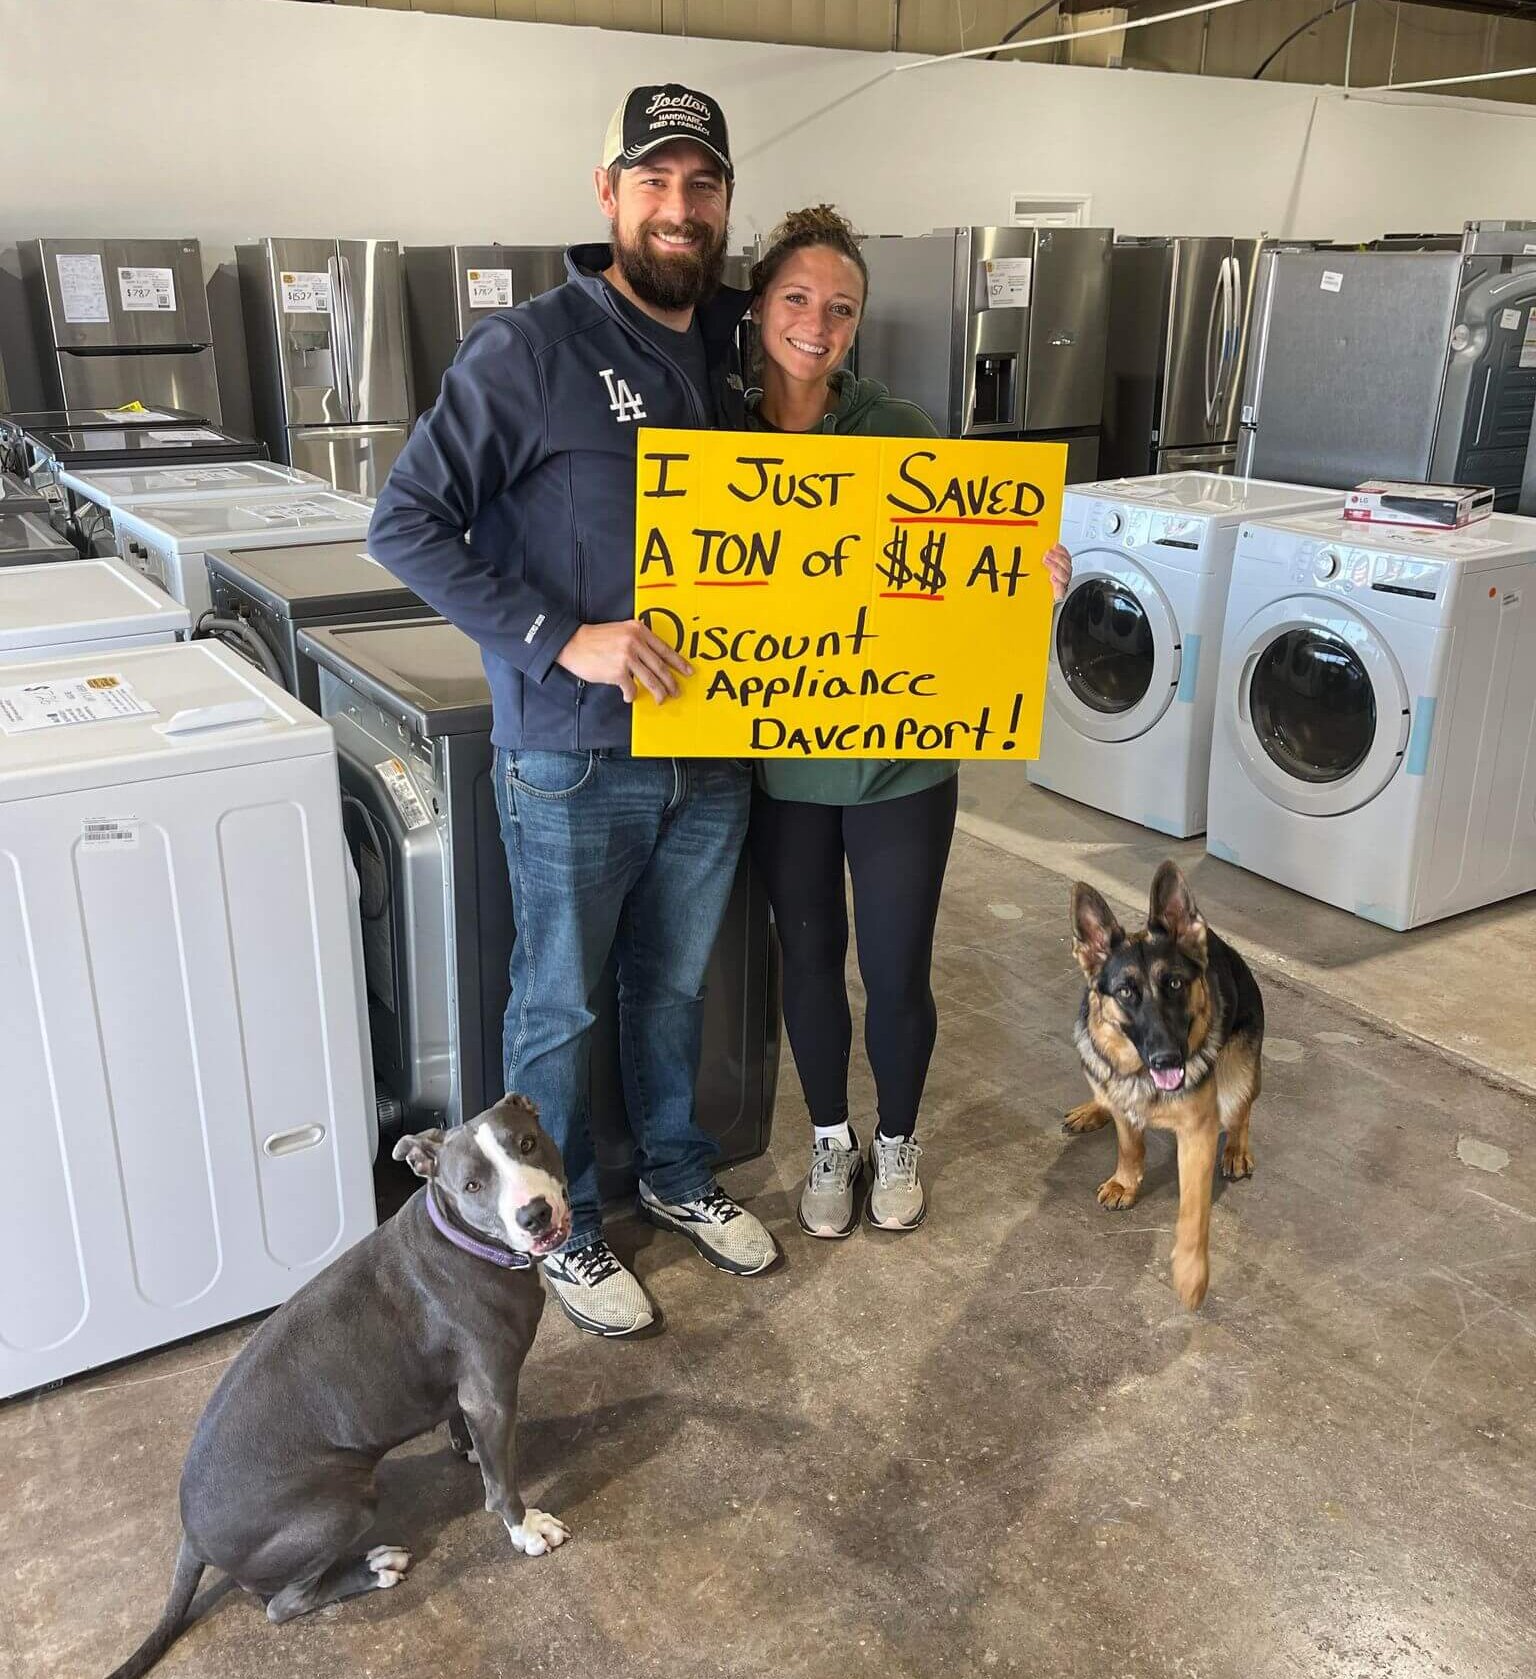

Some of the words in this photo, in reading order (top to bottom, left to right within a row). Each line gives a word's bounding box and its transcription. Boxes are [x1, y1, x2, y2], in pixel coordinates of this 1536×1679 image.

[646, 92, 710, 117] Joelton
[649, 120, 668, 131] FEED
[599, 368, 647, 422] LA
[643, 452, 690, 498] I
[727, 456, 856, 509] JUST
[886, 451, 1046, 517] SAVED
[639, 527, 675, 577] A
[692, 528, 782, 577] TON
[801, 534, 861, 577] of
[875, 525, 947, 595] $$
[966, 545, 1030, 597] At
[637, 606, 880, 663] Discount
[705, 665, 938, 709] Appliance
